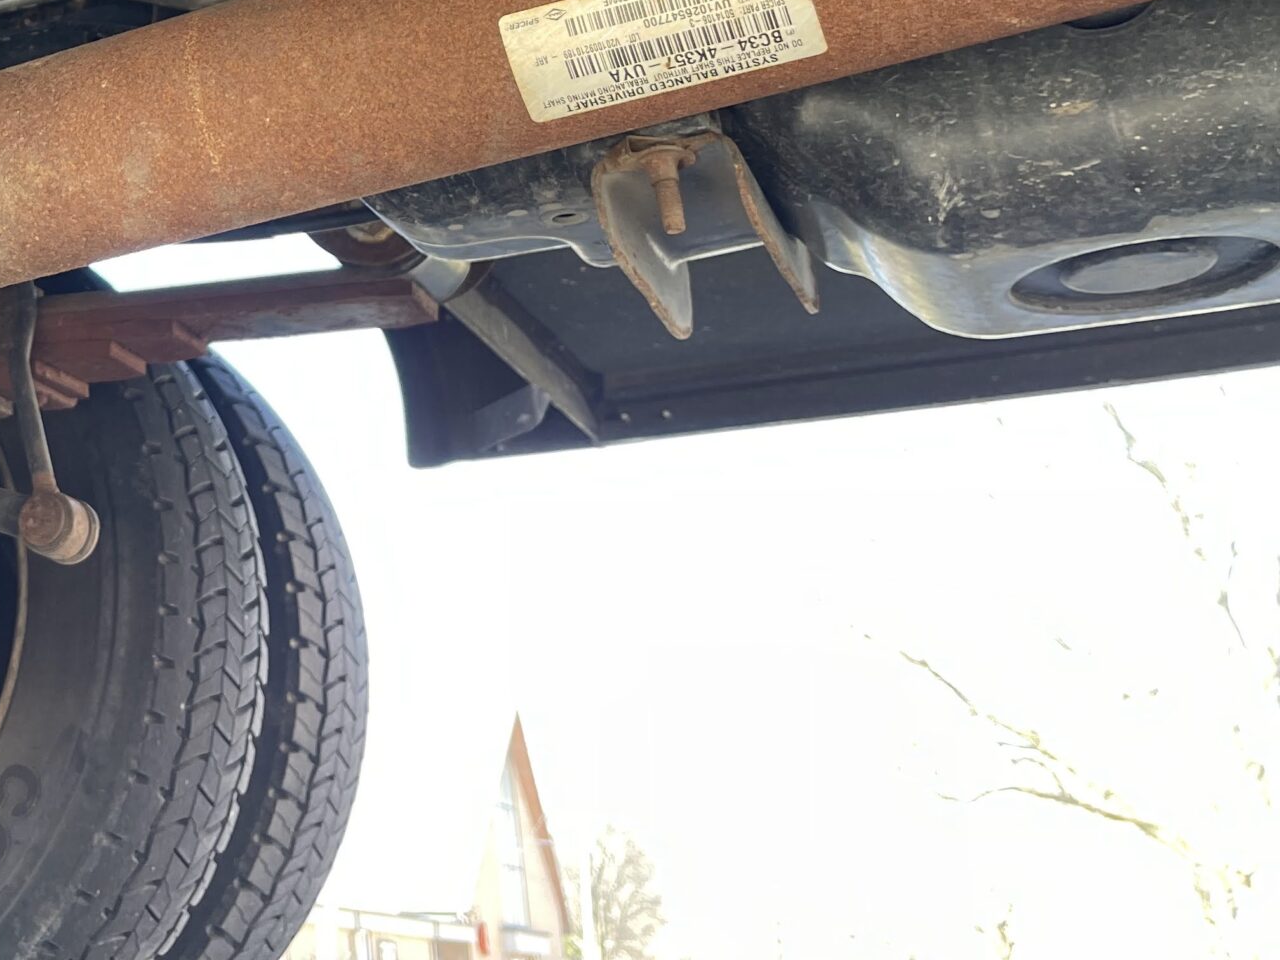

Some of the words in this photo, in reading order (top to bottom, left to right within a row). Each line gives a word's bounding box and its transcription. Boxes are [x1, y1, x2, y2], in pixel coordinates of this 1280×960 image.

[738, 2, 760, 15] PART:
[625, 32, 641, 43] LOT:
[791, 38, 802, 48] DO
[736, 47, 771, 61] REPLACE
[773, 43, 789, 52] NOT
[691, 60, 715, 73] SHAFT
[716, 55, 735, 66] THIS
[723, 53, 778, 74] SYSTEM
[649, 68, 718, 91] BALANCED
[653, 67, 688, 82] WITHOUT
[597, 77, 649, 95] REBALANCING
[543, 96, 566, 109] SHAFT
[566, 90, 596, 103] MATING
[567, 86, 645, 112] DRIVESHAFT
